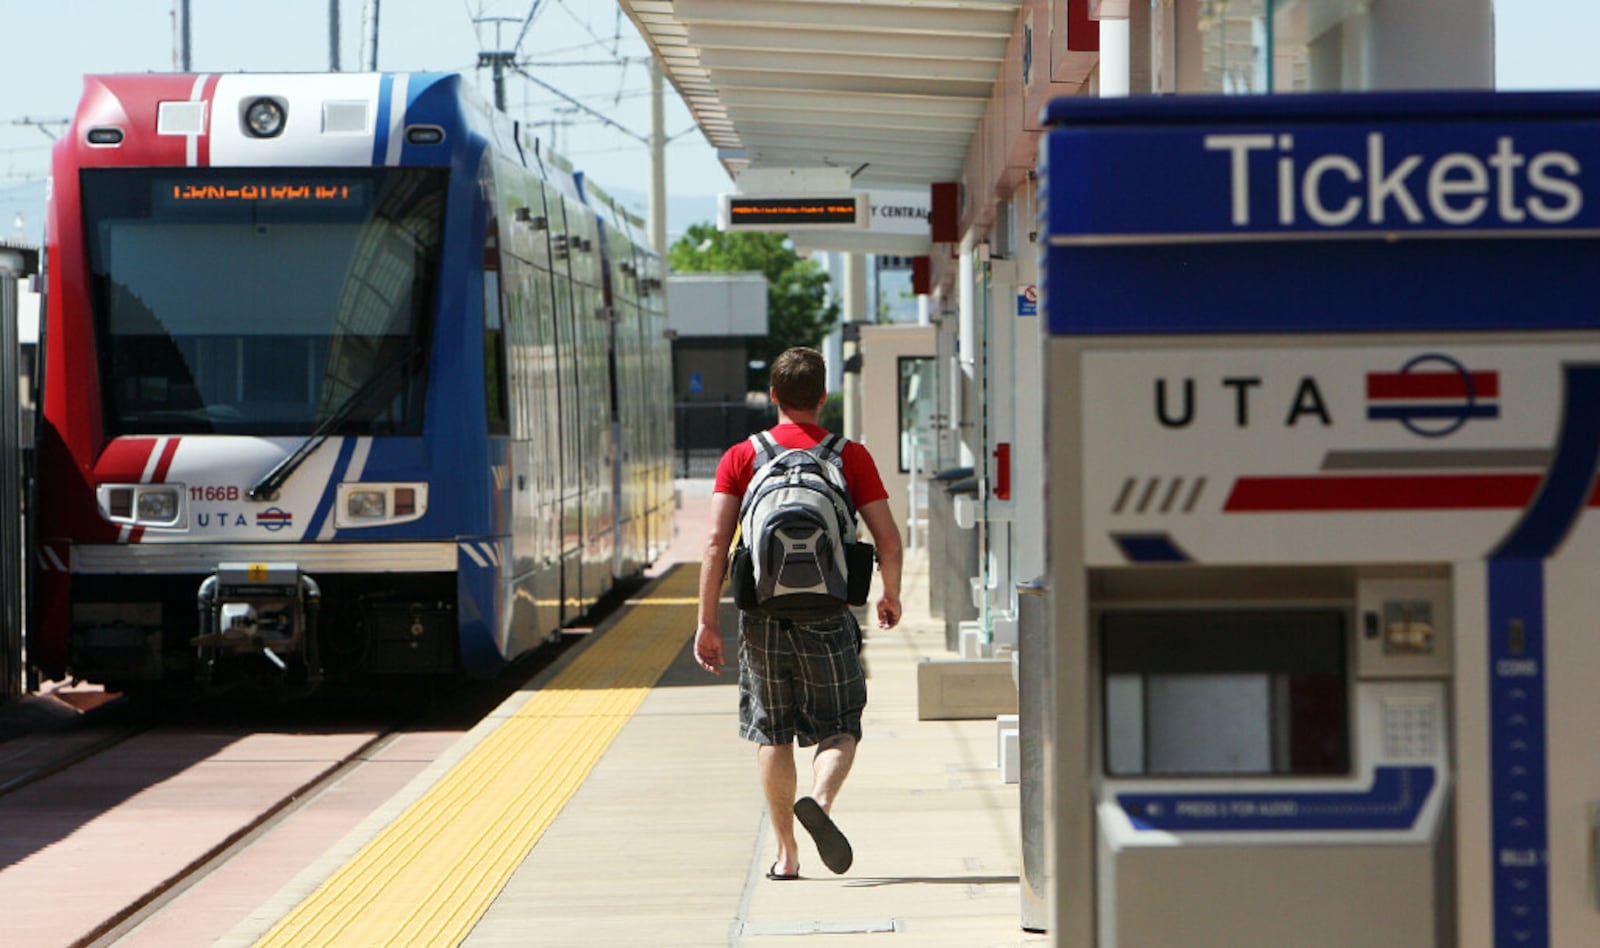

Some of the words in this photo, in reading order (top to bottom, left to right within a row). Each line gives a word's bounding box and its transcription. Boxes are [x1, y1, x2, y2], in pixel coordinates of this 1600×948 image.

[1204, 132, 1584, 226] Tickets
[881, 205, 930, 219] CENTRAL
[1155, 376, 1332, 429] UTA
[189, 486, 239, 501] 1166B
[197, 512, 248, 527] UTA
